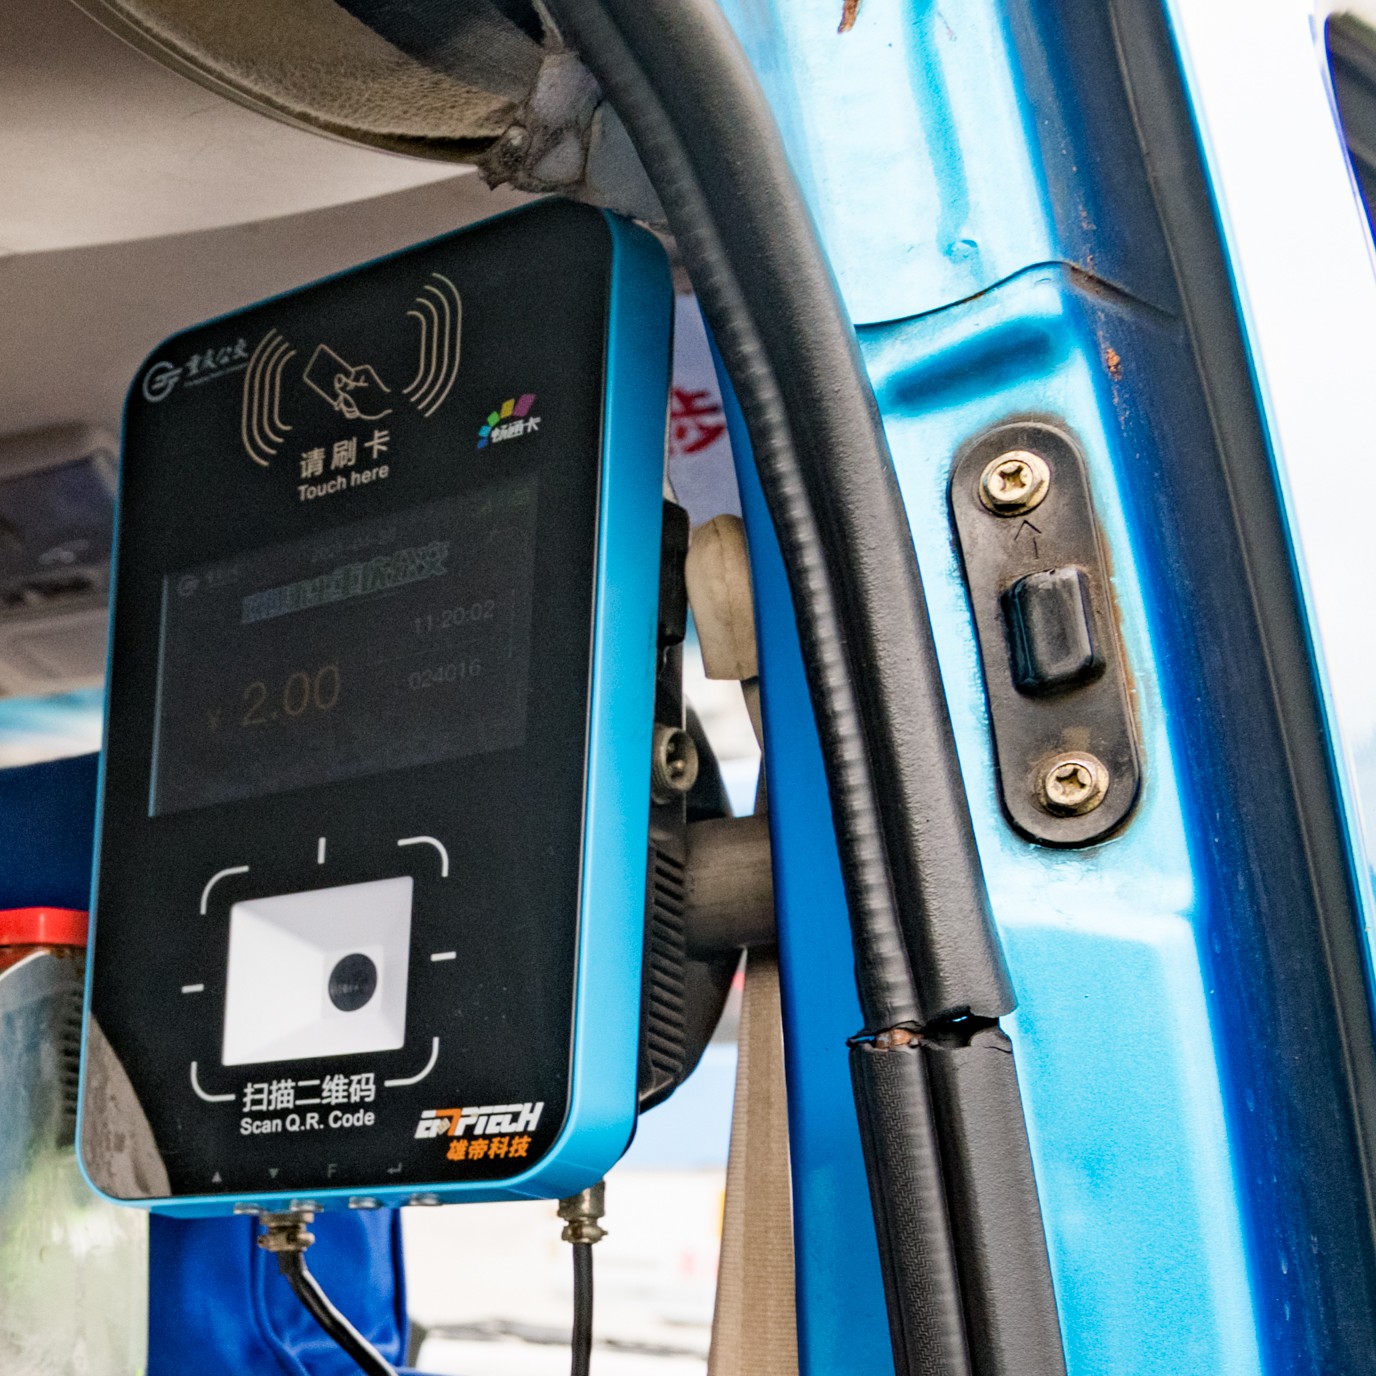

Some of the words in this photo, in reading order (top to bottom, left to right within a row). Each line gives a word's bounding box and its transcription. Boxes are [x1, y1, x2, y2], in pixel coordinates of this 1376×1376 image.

[300, 430, 390, 479] 请刷卡
[298, 477, 347, 502] Touch
[351, 464, 390, 487] here
[241, 663, 343, 727] 2.00
[242, 1072, 376, 1112] 扫描二维码
[240, 1115, 282, 1136] Scan
[286, 1113, 325, 1133] Q.R.
[329, 1108, 376, 1129] Code
[447, 1136, 531, 1161] 雄帝科技
